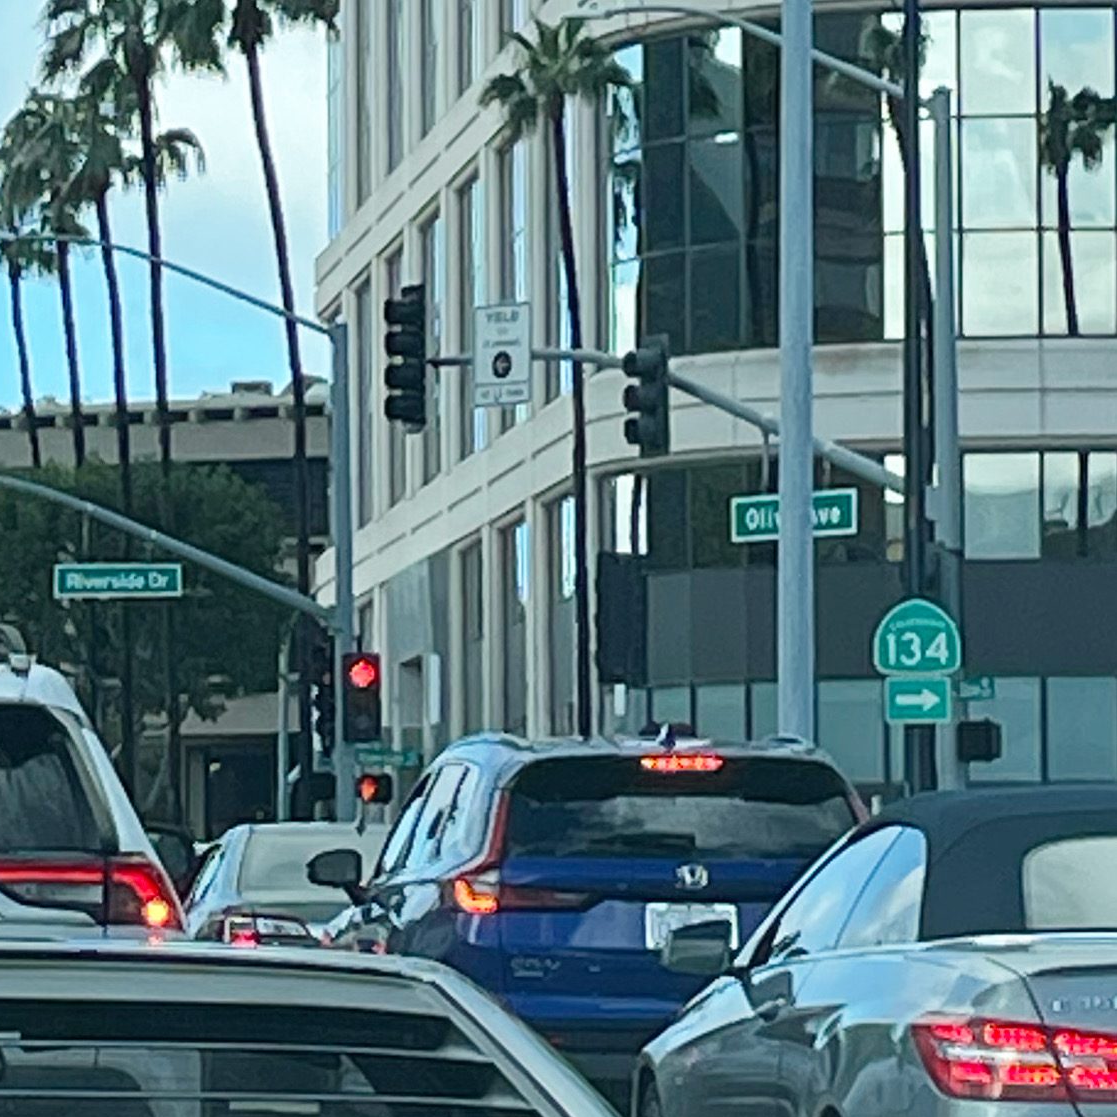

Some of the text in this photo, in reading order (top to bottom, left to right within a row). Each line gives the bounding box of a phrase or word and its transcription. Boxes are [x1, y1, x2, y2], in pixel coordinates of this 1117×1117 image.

[66, 571, 170, 590] Riverside Dr
[886, 631, 949, 666] 134
